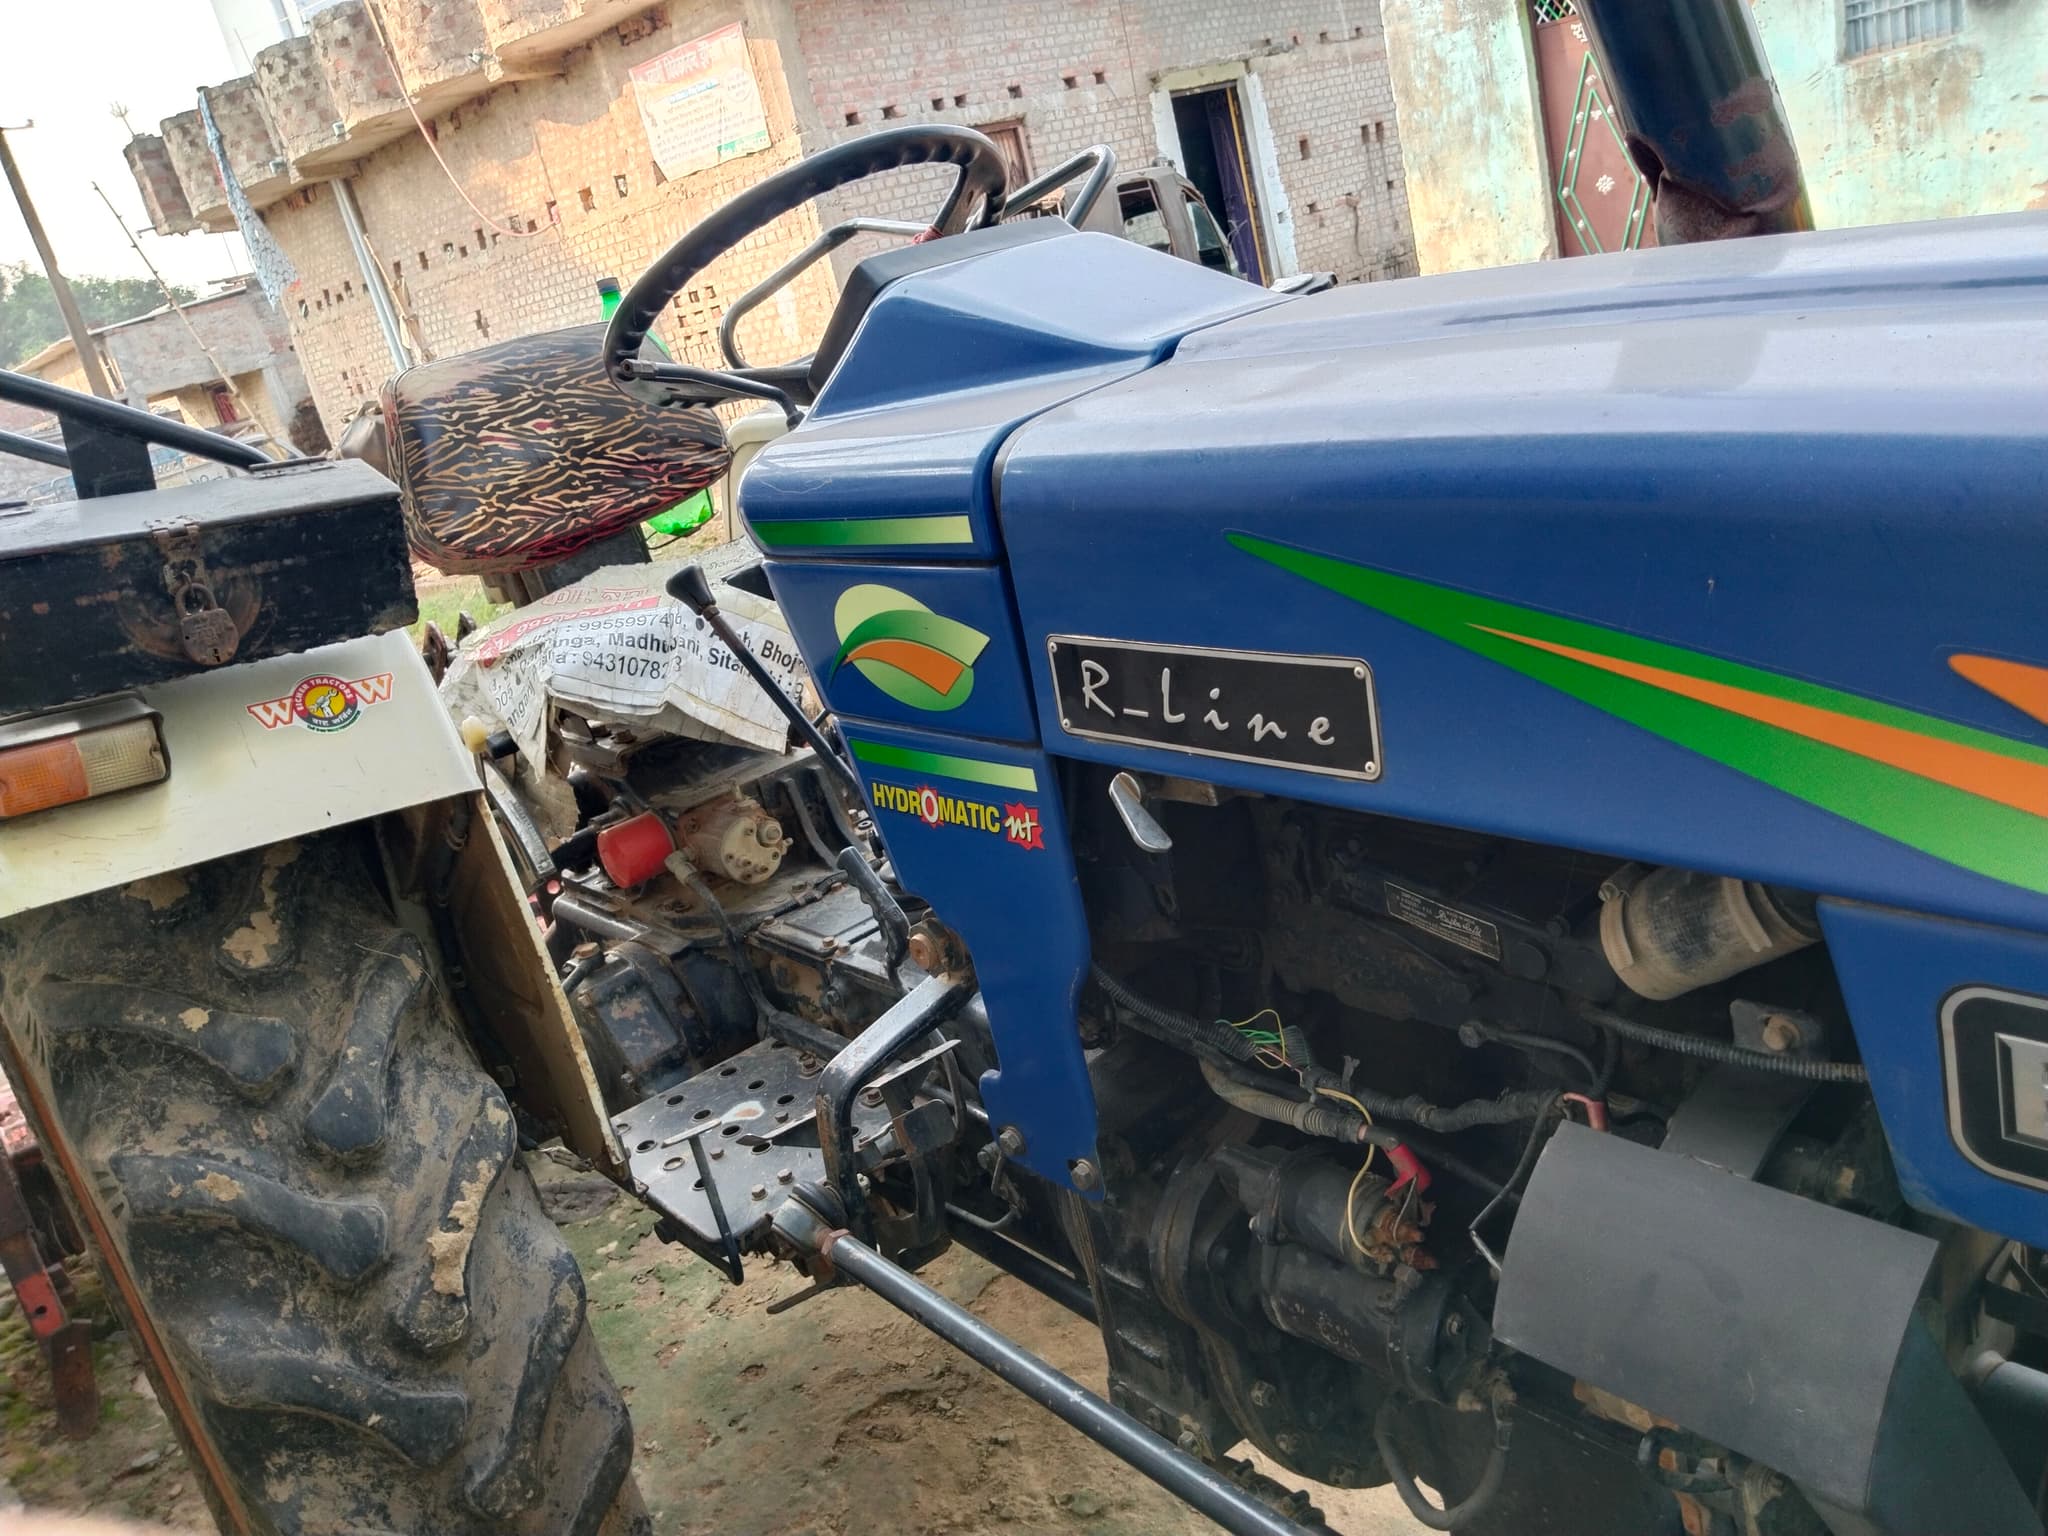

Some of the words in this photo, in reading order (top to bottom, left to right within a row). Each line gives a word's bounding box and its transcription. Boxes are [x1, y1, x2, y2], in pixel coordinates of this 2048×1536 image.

[295, 683, 310, 711] EICHER
[310, 678, 354, 700] TRACTORS
[872, 782, 1000, 833] HYDROMATIC
